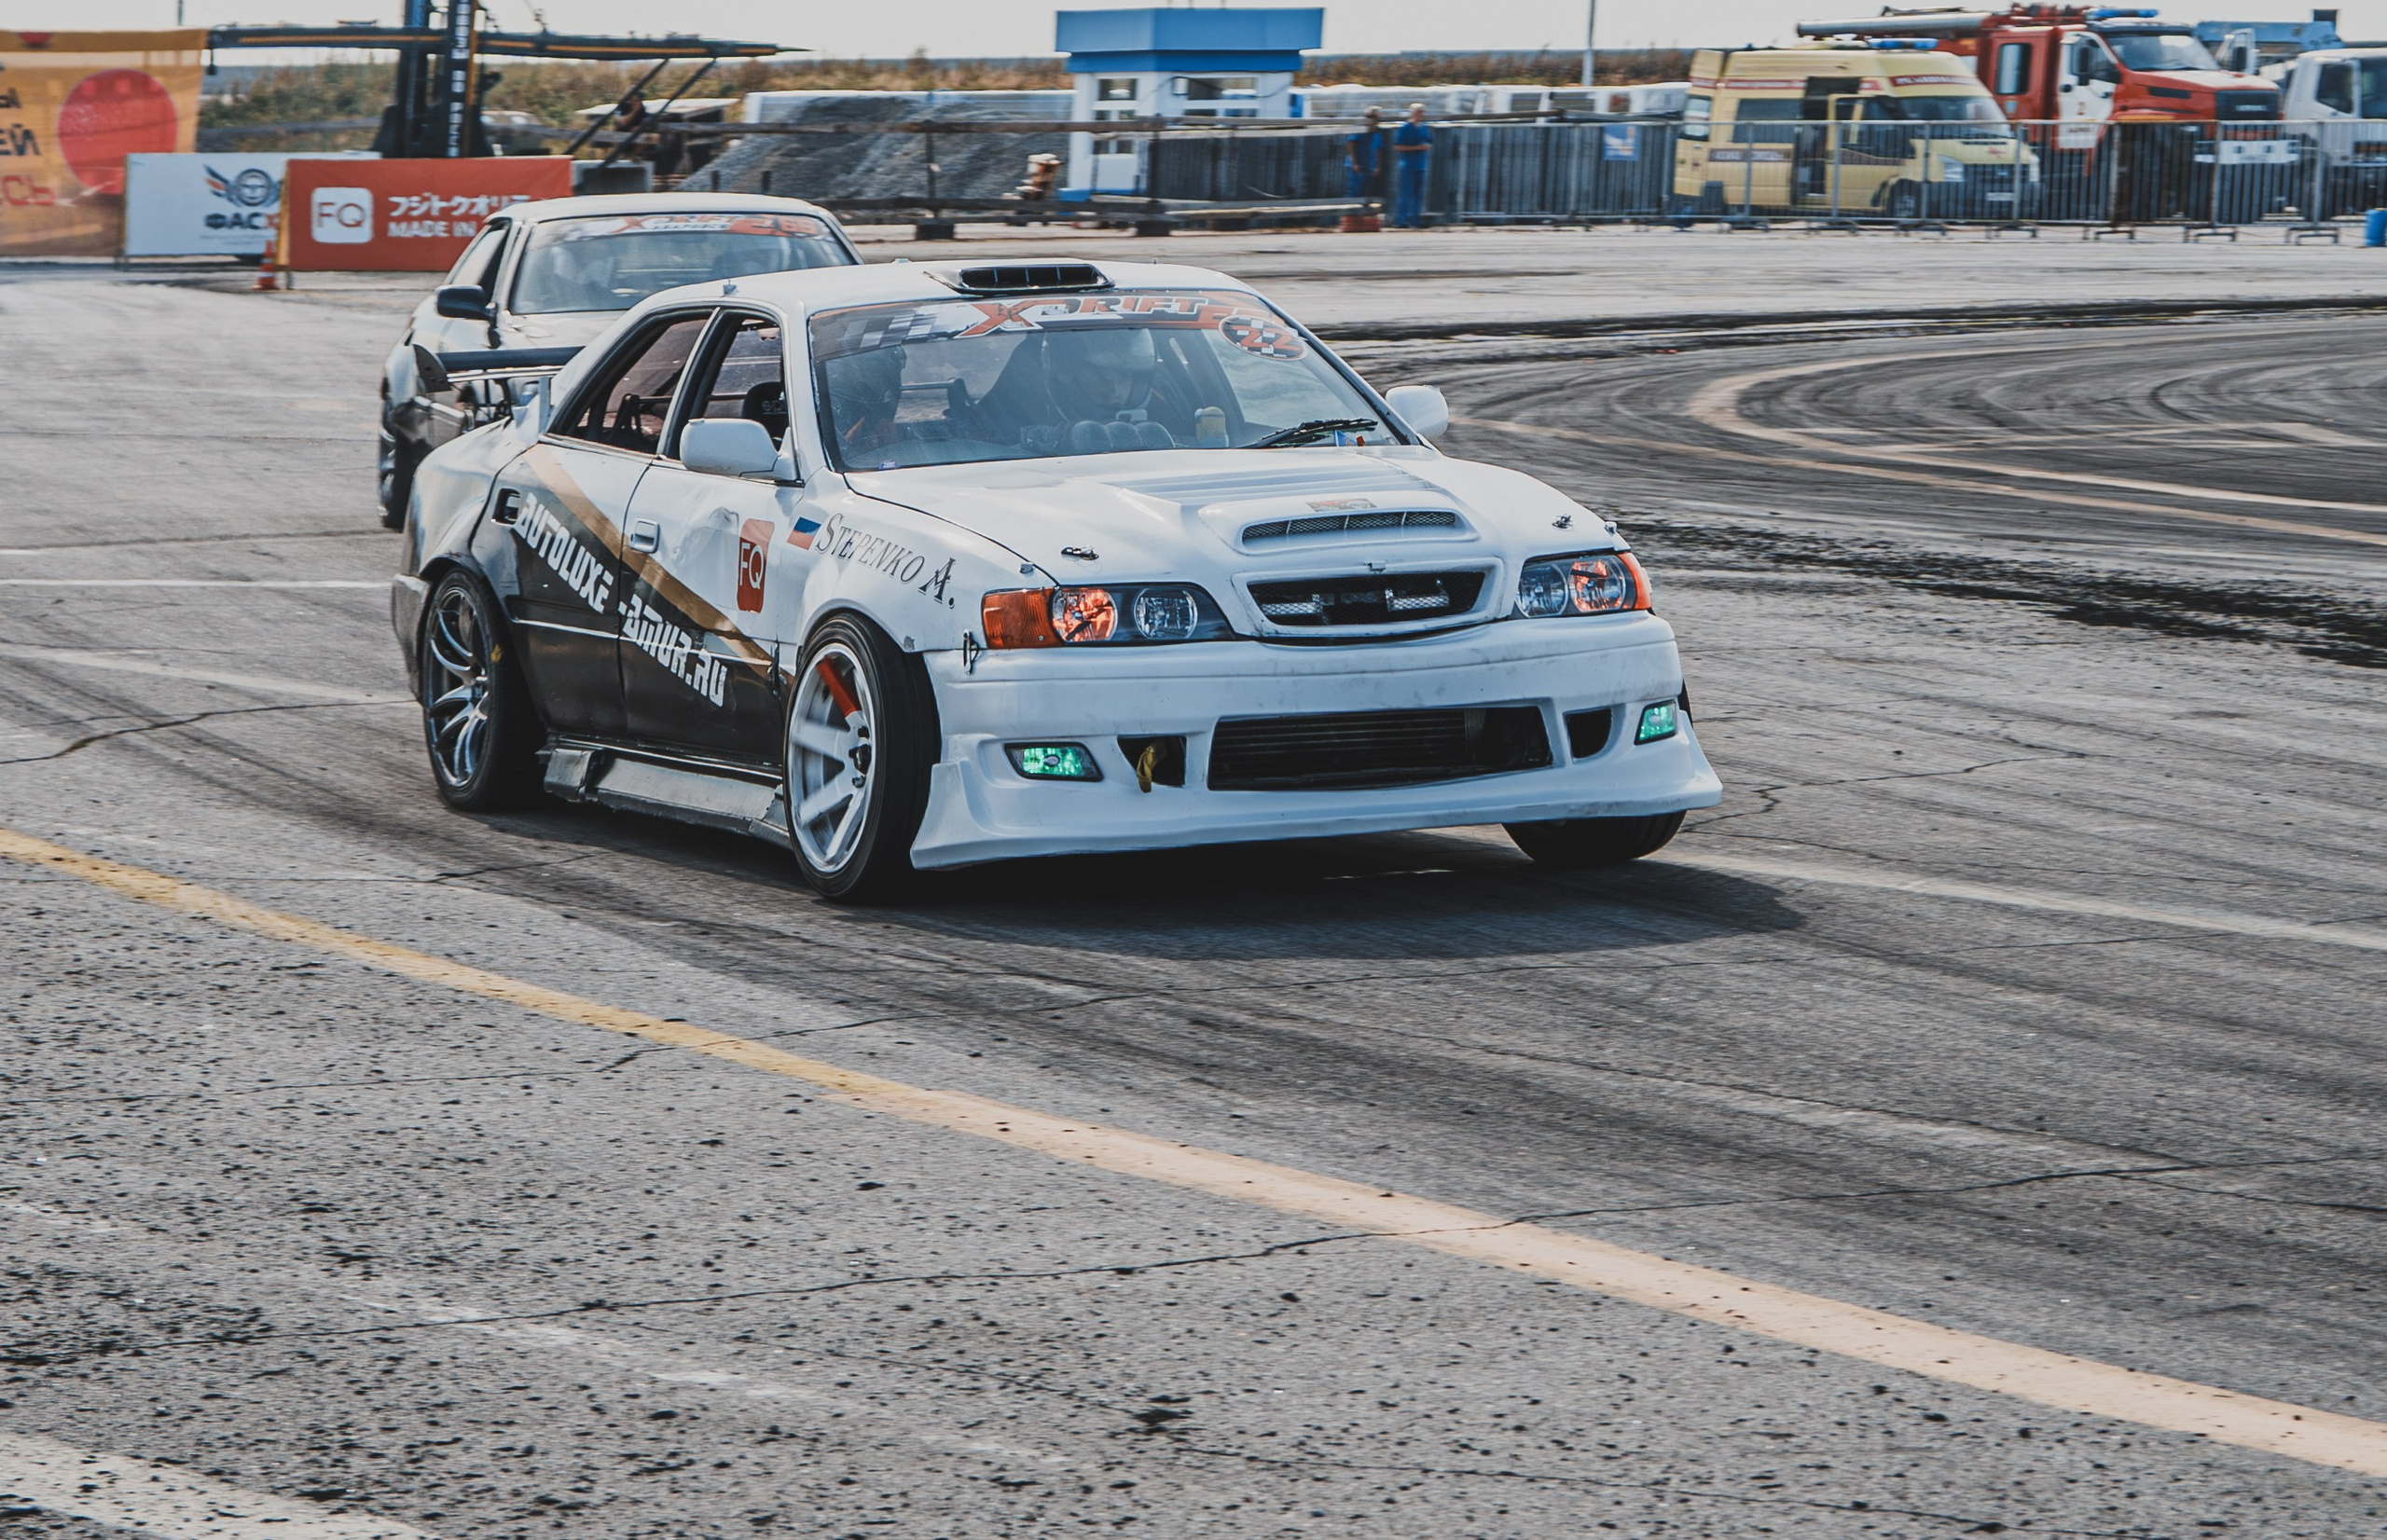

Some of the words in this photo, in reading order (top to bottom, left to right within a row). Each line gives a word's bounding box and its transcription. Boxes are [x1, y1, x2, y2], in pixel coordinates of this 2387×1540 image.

[318, 201, 366, 228] FQ
[386, 220, 448, 238] MADE
[452, 220, 478, 238] IN
[1232, 324, 1302, 352] 22
[815, 513, 925, 584] STEPENKO
[738, 542, 765, 590] FQ
